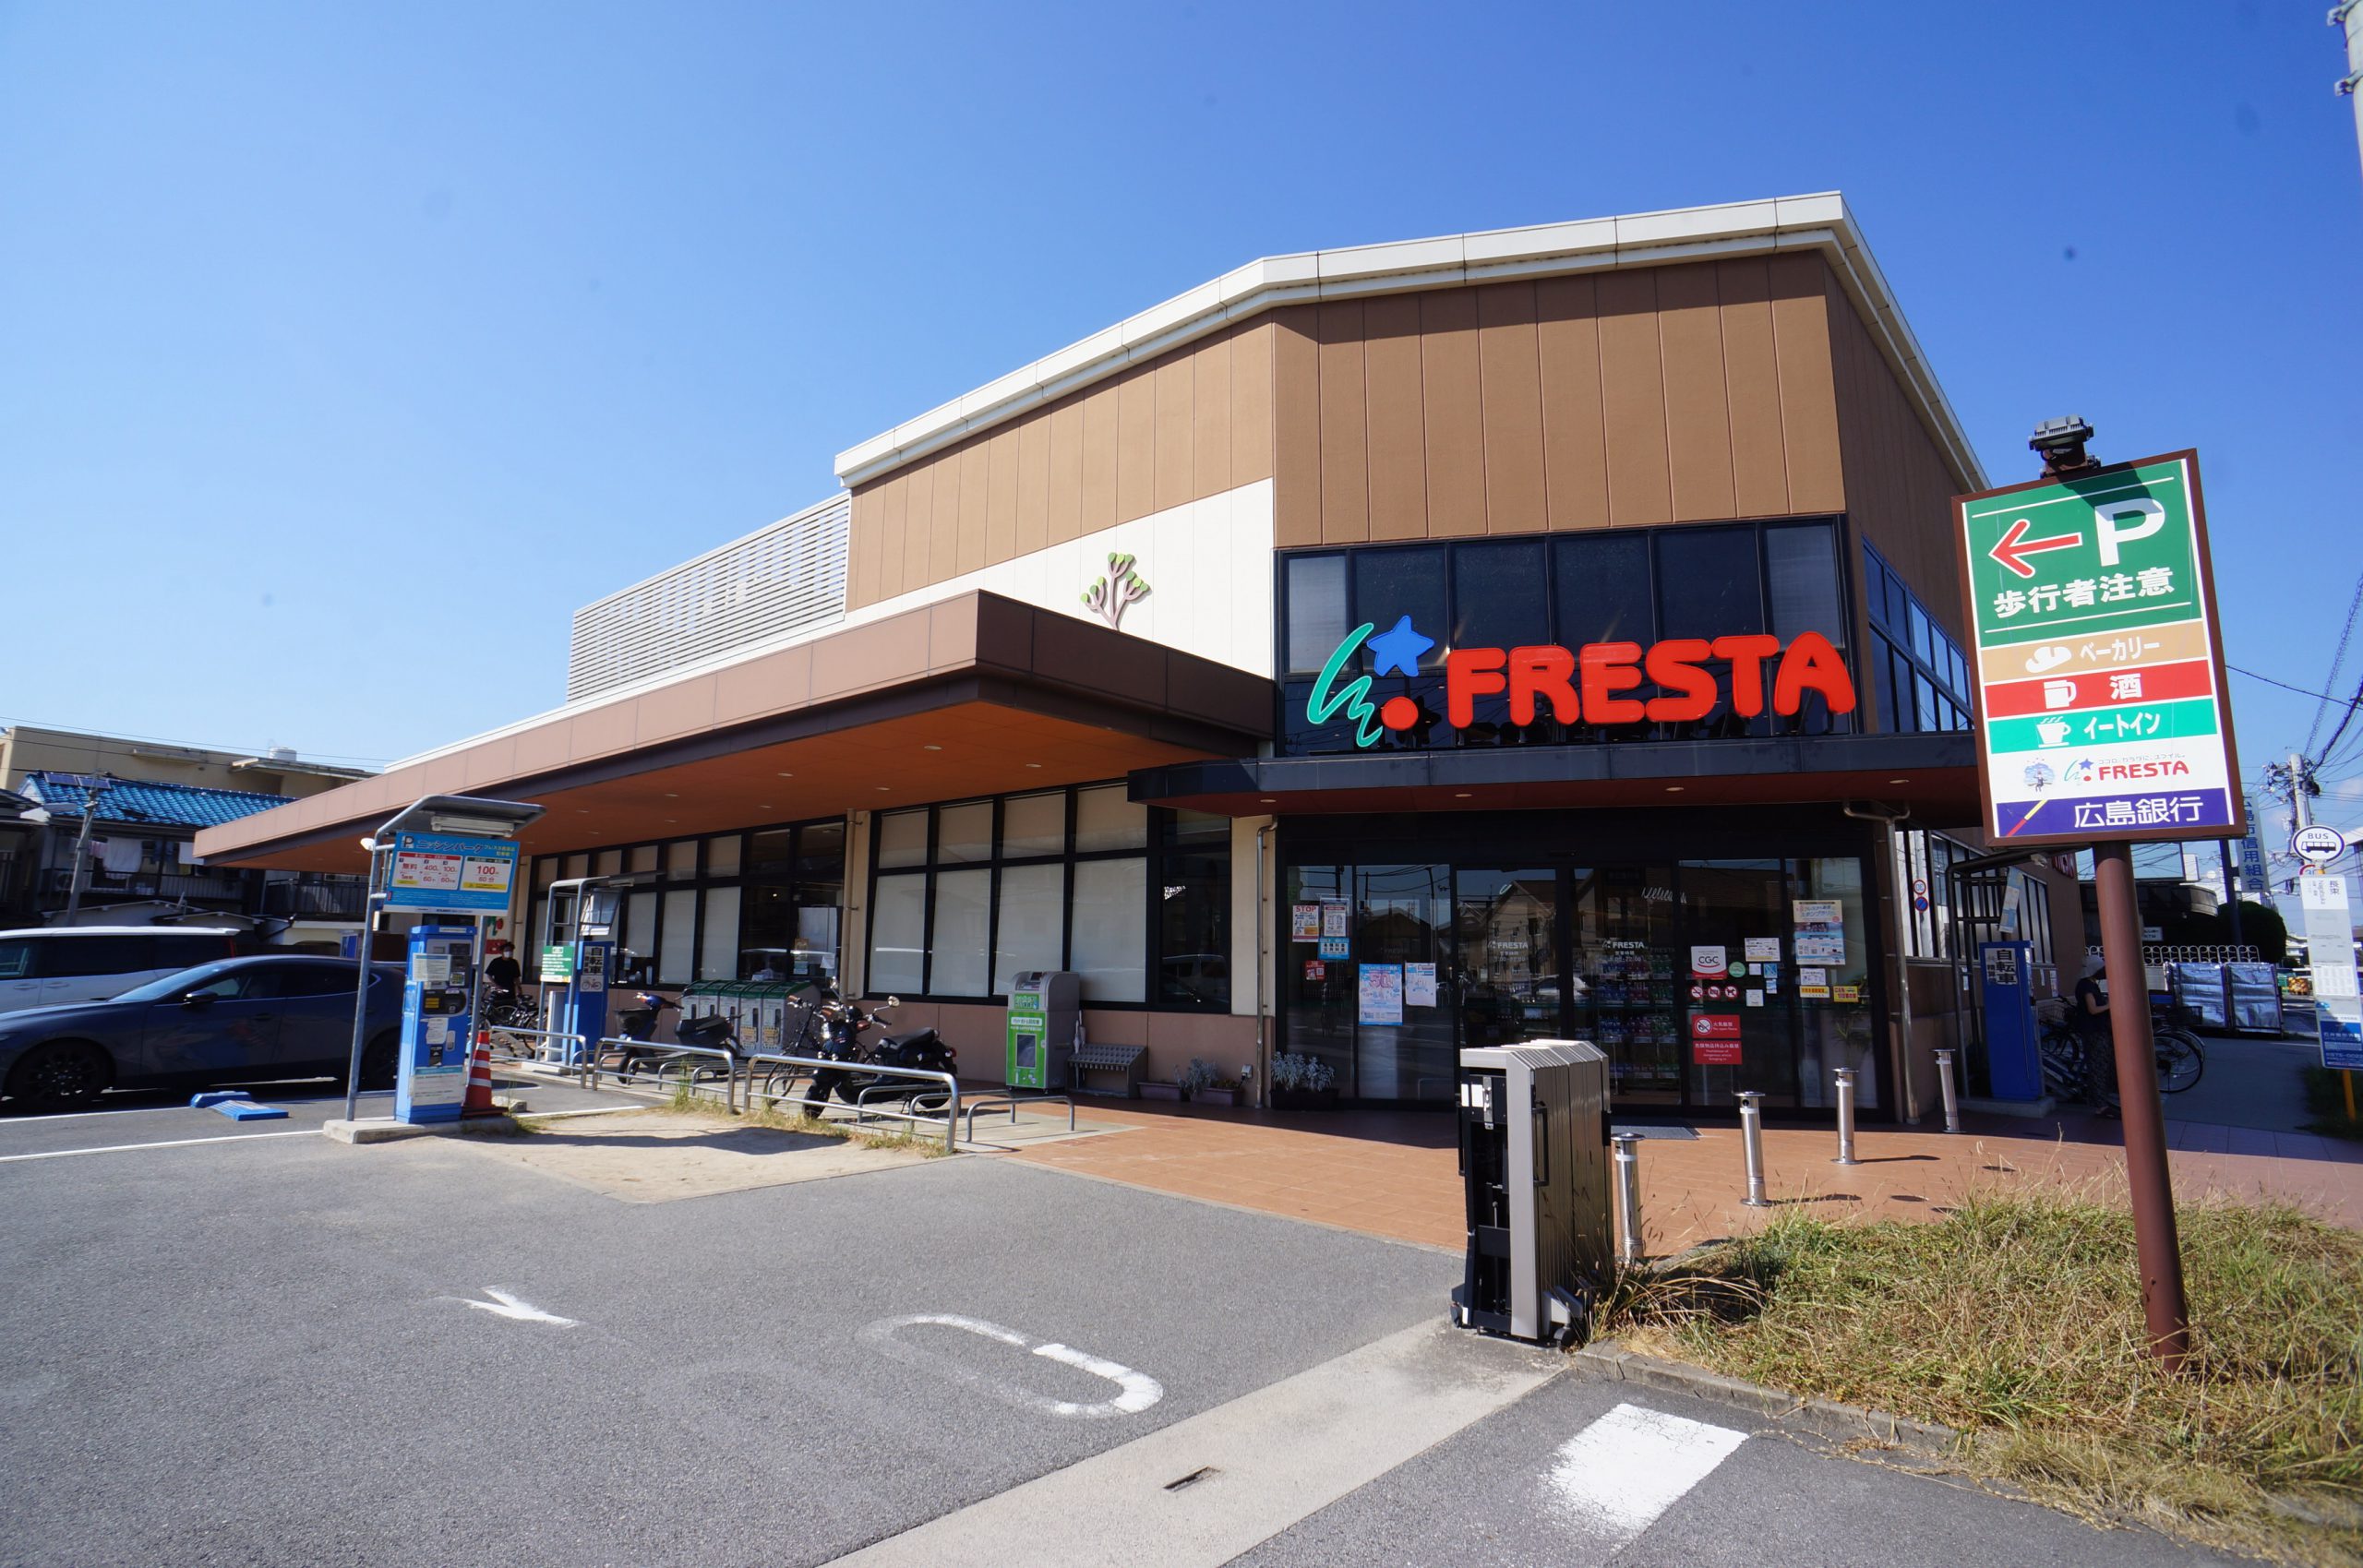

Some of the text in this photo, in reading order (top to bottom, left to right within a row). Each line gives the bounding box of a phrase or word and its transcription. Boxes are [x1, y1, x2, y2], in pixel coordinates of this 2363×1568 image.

[2094, 497, 2165, 567] P
[1994, 567, 2175, 617] 歩行者注意
[2080, 638, 2161, 661] ベーカリー
[1446, 631, 1855, 728] FRESTA
[2110, 674, 2142, 700] 酒
[2083, 712, 2161, 740] イートイン
[2098, 760, 2189, 781] FRESTA
[2074, 796, 2204, 828] 広島銀行
[1497, 941, 1529, 950] FRESTA
[1613, 941, 1645, 950] FRESTA
[1996, 950, 2017, 984] 自転車
